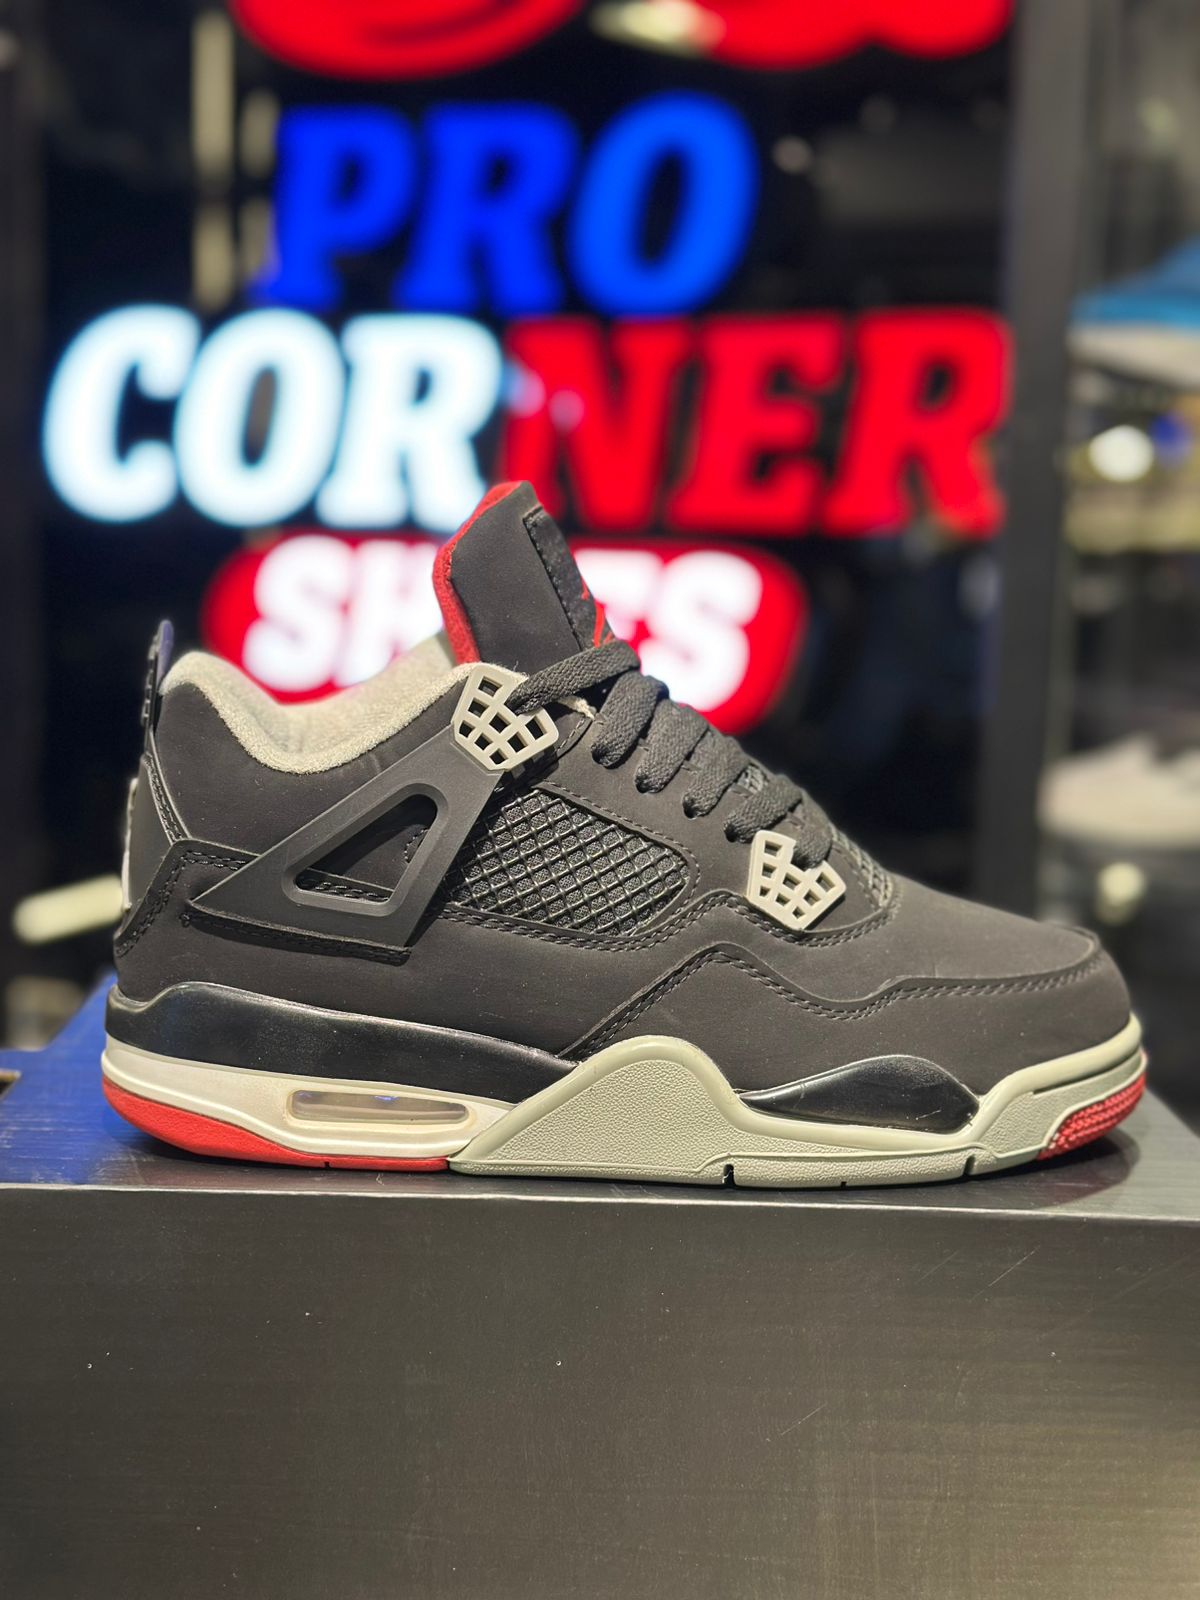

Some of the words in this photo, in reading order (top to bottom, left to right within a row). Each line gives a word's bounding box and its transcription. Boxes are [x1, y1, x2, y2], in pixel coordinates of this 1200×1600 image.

[257, 93, 756, 316] PRO
[43, 304, 1012, 537] CORNER
[243, 535, 763, 712] SHS
